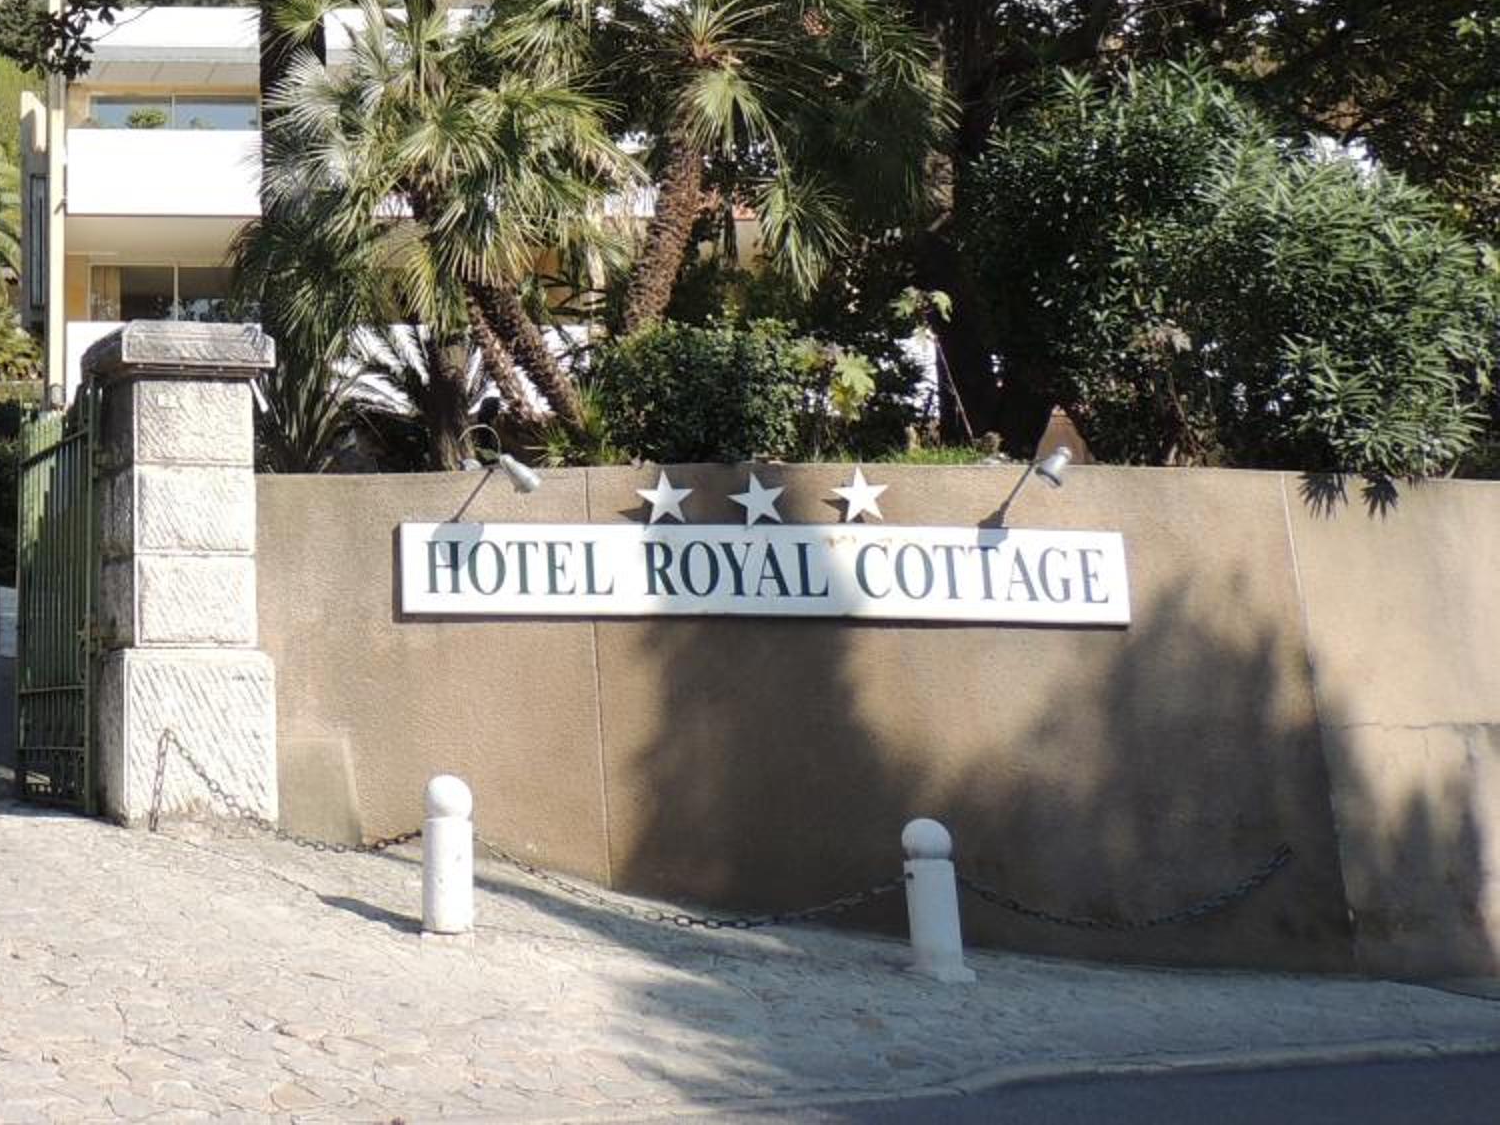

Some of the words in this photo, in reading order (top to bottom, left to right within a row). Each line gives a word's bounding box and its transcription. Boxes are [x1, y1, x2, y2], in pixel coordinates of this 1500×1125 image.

[426, 540, 615, 596] HOTEL
[643, 540, 830, 598] ROYAL
[856, 543, 1110, 604] COTTAGE
